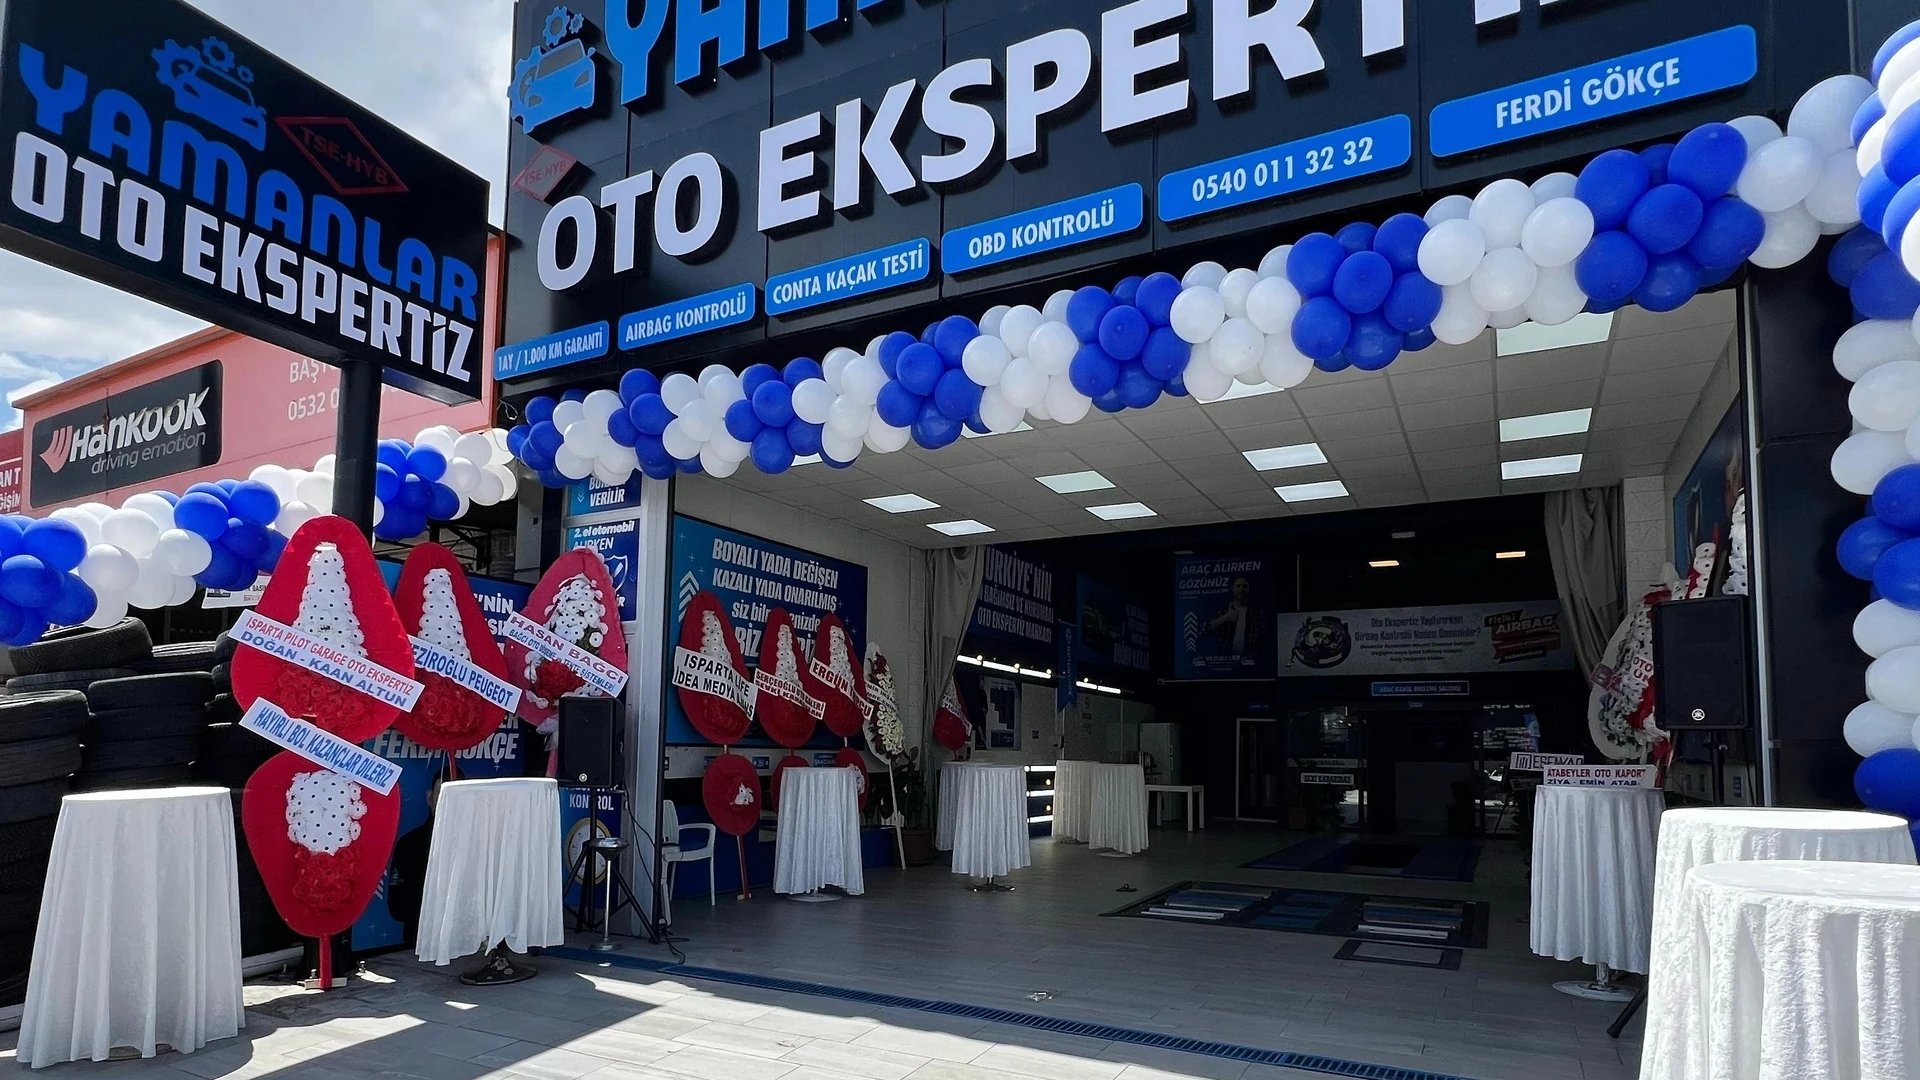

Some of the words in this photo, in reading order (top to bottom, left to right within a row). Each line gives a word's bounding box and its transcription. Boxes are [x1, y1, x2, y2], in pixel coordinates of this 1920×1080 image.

[1495, 79, 1572, 129] FERDİ
[1582, 57, 1681, 106] GÖKÇE
[302, 131, 389, 184] TSE-HYB
[537, 152, 723, 291] OTO
[757, 0, 1560, 232] EKSPER
[1191, 168, 1247, 202] 0540
[1254, 154, 1294, 187] 011
[1304, 146, 1335, 175] 32
[1343, 136, 1374, 166] 32
[19, 42, 477, 321] YAMANLAR
[967, 232, 1006, 260] OBD
[1011, 198, 1115, 247] KONTROLÜ
[11, 131, 166, 263] OTO
[182, 204, 474, 384] EKSPERTİZ
[772, 276, 822, 304] CONTA
[826, 260, 878, 295] KAÇAK
[882, 243, 924, 278] TESTİ
[625, 312, 672, 343] AIRBAG
[675, 289, 747, 330] KONTROLÜ
[524, 346, 547, 366] 1.000
[549, 342, 562, 361] KM
[564, 327, 603, 356] GARANTİ
[288, 392, 326, 421] 0532
[91, 446, 138, 475] driving
[142, 431, 206, 461] emotion
[589, 487, 626, 507] VERİLİR
[592, 520, 635, 536] otomobil
[712, 538, 759, 569] BOYALI
[761, 550, 791, 578] YADA
[793, 559, 839, 590] DEĞİŞEN
[1181, 564, 1211, 576] ARAÇ
[1213, 561, 1262, 573] ALIRKEN
[712, 567, 753, 594] KAZALI
[755, 577, 782, 601] YADA
[784, 585, 838, 614] ONARILMIŞ
[510, 615, 565, 650] HASAN
[977, 606, 992, 627] OTO
[992, 610, 1025, 637] EKSPERTİZ
[241, 630, 297, 659] DOĞAN
[307, 657, 354, 684] KAAN
[355, 681, 407, 707] ALTUN
[245, 617, 284, 641] ISPARTA
[284, 631, 312, 650] PİLOT
[310, 643, 348, 666] GARAGE
[348, 658, 366, 675] OTO
[367, 668, 415, 696] EKSPERTİZ
[528, 638, 539, 651] OTO
[581, 668, 615, 692] SİSTEMLERİ
[684, 654, 734, 683] ISPARTA
[812, 661, 848, 692] ERGÜN
[468, 670, 514, 707] PEUGEOT
[703, 677, 735, 701] MEDYA
[253, 707, 290, 738] HAYIRLI
[286, 724, 311, 751] BOL
[305, 733, 361, 773] KAZANÇLAR
[355, 756, 395, 788] DİLERİZ
[1547, 768, 1590, 778] ATABEYLER
[1594, 768, 1611, 778] OTO
[1579, 778, 1605, 786] EMİN
